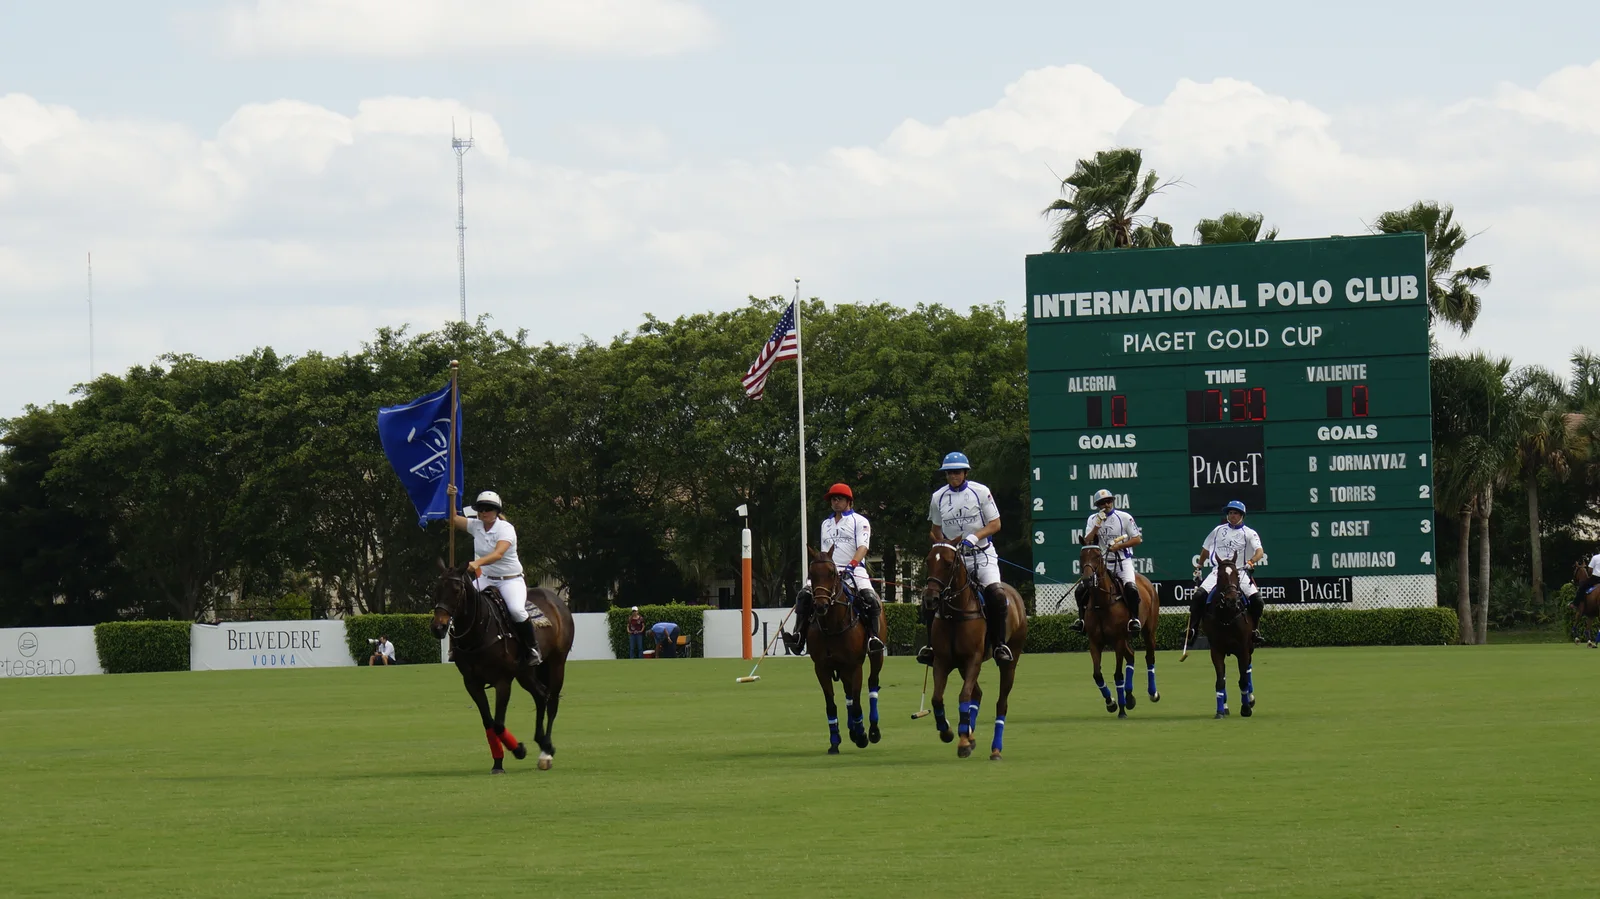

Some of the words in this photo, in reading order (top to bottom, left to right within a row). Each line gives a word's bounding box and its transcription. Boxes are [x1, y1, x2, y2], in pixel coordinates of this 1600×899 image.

[1033, 284, 1246, 318] INTERNATIONAL
[1258, 280, 1332, 307] POLO
[1346, 276, 1418, 302] CLUB
[1124, 332, 1196, 352] PIAGET
[1208, 328, 1269, 350] GOLD
[1282, 326, 1322, 346] CUP
[1204, 369, 1246, 384] TIME
[1306, 364, 1366, 382] VALIENTE
[1068, 375, 1116, 393] ALEGRIA
[1352, 385, 1368, 416] 0
[1112, 396, 1127, 426] 0
[1318, 424, 1378, 440] GOALS
[1078, 434, 1136, 449] GOALS
[1033, 468, 1040, 480] 1
[1070, 465, 1077, 480] J
[1089, 462, 1138, 479] MANNIX
[1192, 453, 1262, 488] PIAGET
[1309, 456, 1317, 472] B
[1330, 453, 1406, 471] JORNAYVAZ
[1419, 454, 1426, 467] 1
[1033, 498, 1044, 511] 2
[1071, 496, 1077, 510] H
[1090, 494, 1130, 509] UOA
[1310, 488, 1318, 503] S
[1330, 486, 1376, 502] TORRES
[1419, 485, 1430, 498] 2
[1311, 522, 1319, 537] S
[1331, 520, 1369, 536] CASET
[1420, 519, 1431, 533] 3
[1035, 531, 1045, 544] 3
[1036, 562, 1046, 574] 4
[1312, 554, 1320, 569] A
[1332, 551, 1395, 568] CAMBIASO
[1420, 552, 1431, 565] 4
[1300, 578, 1349, 602] PIAGET
[227, 630, 321, 652] BELVEDERE
[253, 654, 295, 666] VODKA
